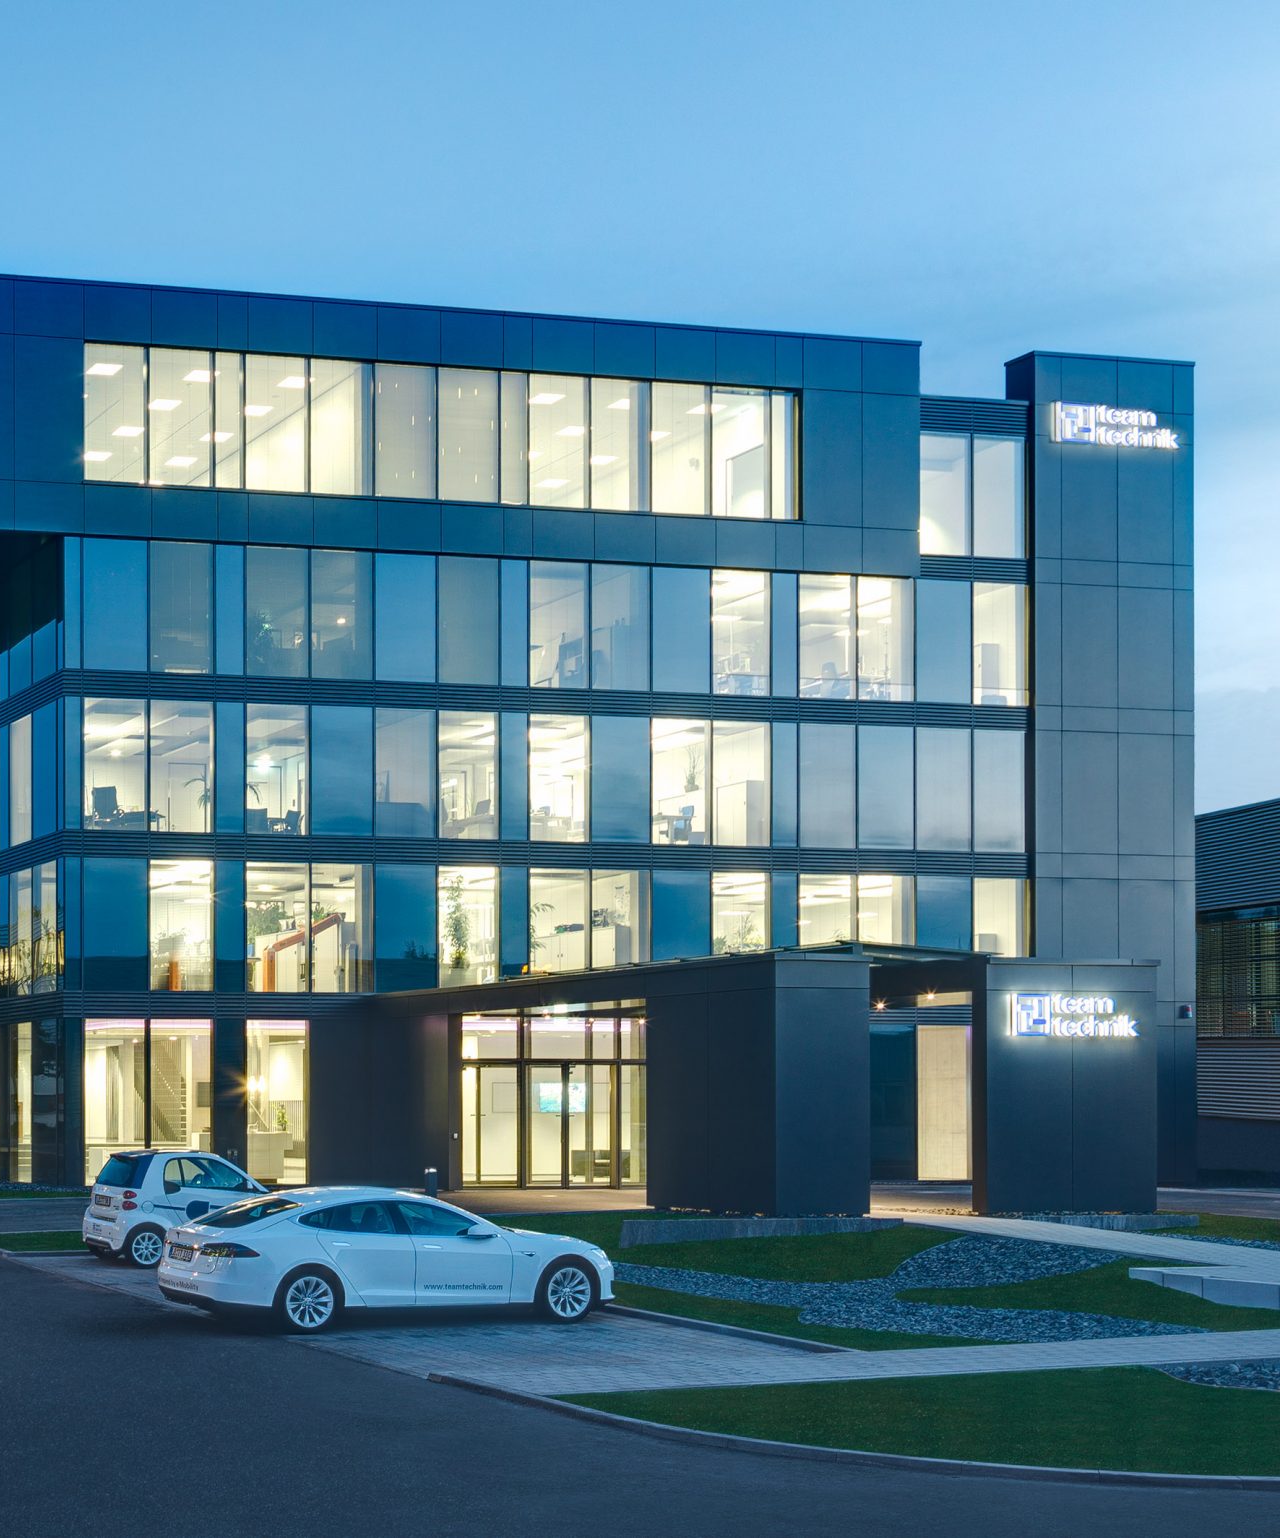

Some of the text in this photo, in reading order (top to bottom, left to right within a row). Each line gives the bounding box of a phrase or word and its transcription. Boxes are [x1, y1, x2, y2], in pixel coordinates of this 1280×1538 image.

[1096, 405, 1158, 426] team
[1096, 427, 1179, 449] technik
[1051, 994, 1114, 1014] team
[1051, 1015, 1139, 1037] technik
[423, 1283, 503, 1291] www.teamtechnik.com
